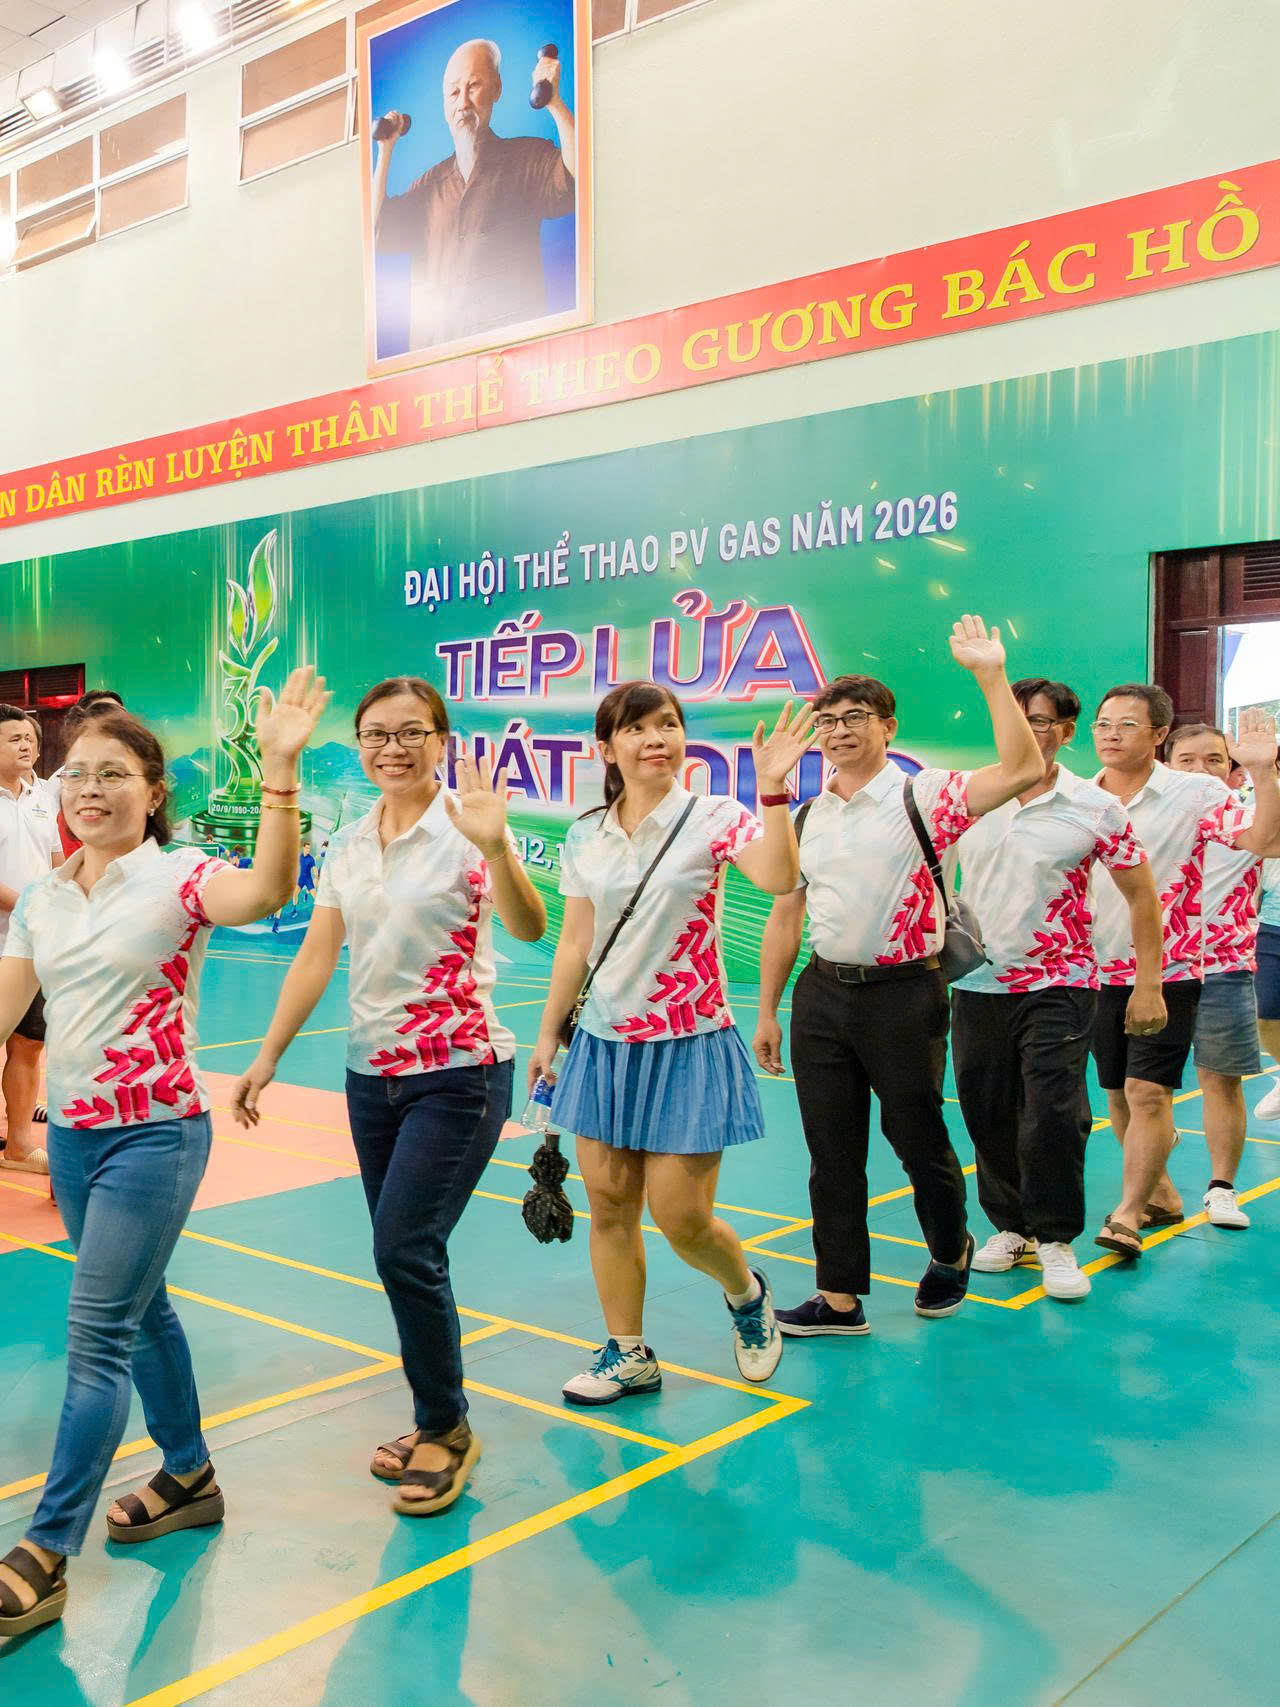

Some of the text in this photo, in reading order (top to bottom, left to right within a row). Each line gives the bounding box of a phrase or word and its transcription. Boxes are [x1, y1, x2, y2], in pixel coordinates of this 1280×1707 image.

[25, 471, 87, 513] DÂN
[95, 454, 156, 498] RÈN
[165, 428, 274, 484] LUYỆN
[287, 400, 400, 457] THÂN
[414, 355, 505, 430] THỂ
[519, 343, 662, 406] THEO
[681, 282, 917, 372] GƯƠNG
[941, 240, 1096, 319] BÁC
[1125, 180, 1261, 281] HỒ
[404, 490, 958, 613] ĐẠI HỘI THỂ THAO PV GAS NĂM 2026
[436, 588, 828, 702] TIẾP LỬA
[438, 721, 590, 804] HÁT
